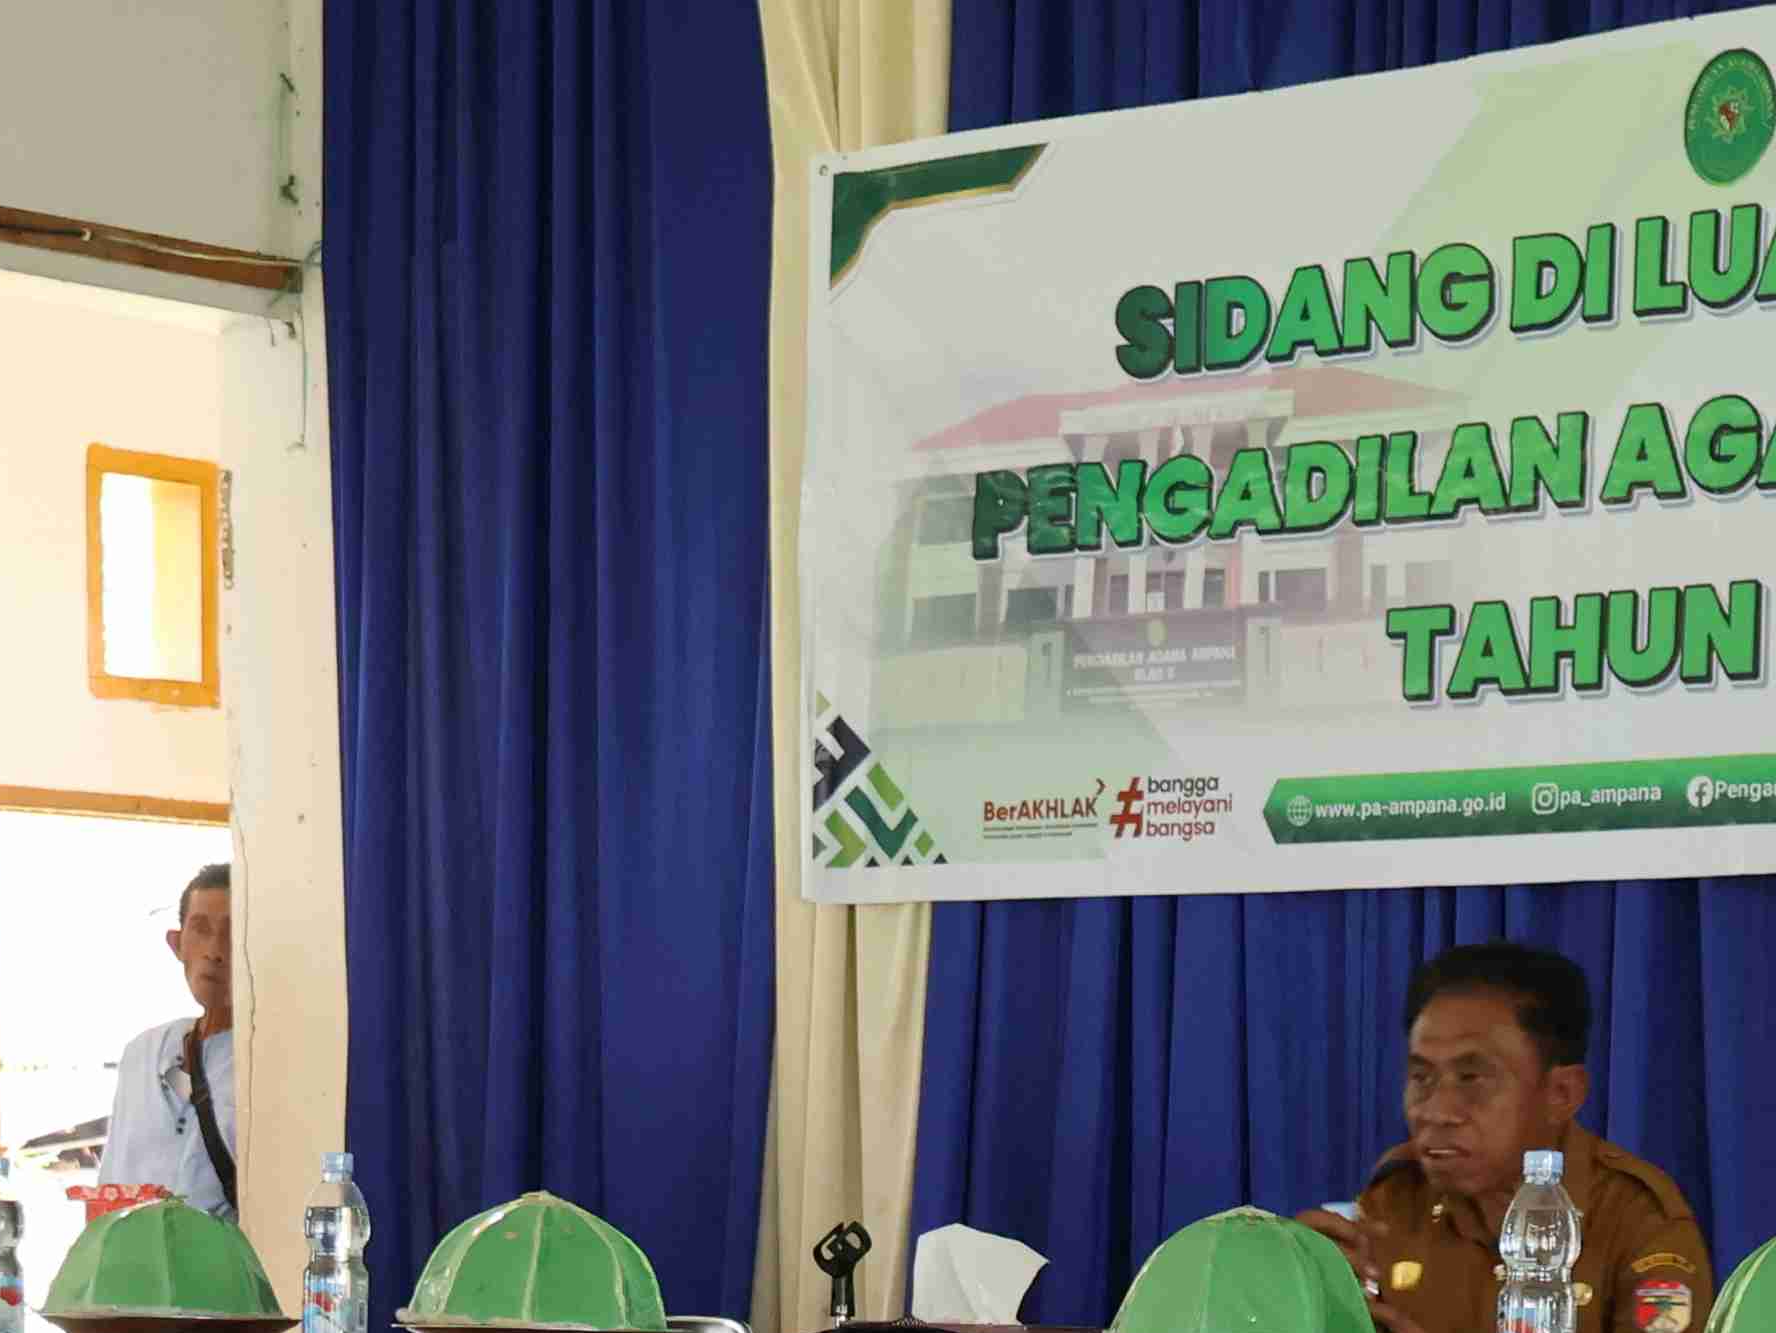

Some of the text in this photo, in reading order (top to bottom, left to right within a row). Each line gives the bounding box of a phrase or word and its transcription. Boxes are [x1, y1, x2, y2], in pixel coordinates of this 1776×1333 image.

[1115, 242, 1495, 380] SIDANG
[1510, 222, 1616, 333] DI
[972, 411, 1589, 560] PENGADILAN
[1387, 580, 1767, 700] TAHUN
[1147, 776, 1220, 797] bangga
[1559, 783, 1662, 809] pa_ampana
[983, 797, 1098, 822] BerAKHLAK
[1146, 794, 1233, 818] melayani
[1315, 791, 1506, 819] www.pa-ampana.go.id
[1146, 819, 1215, 841] bangsa
